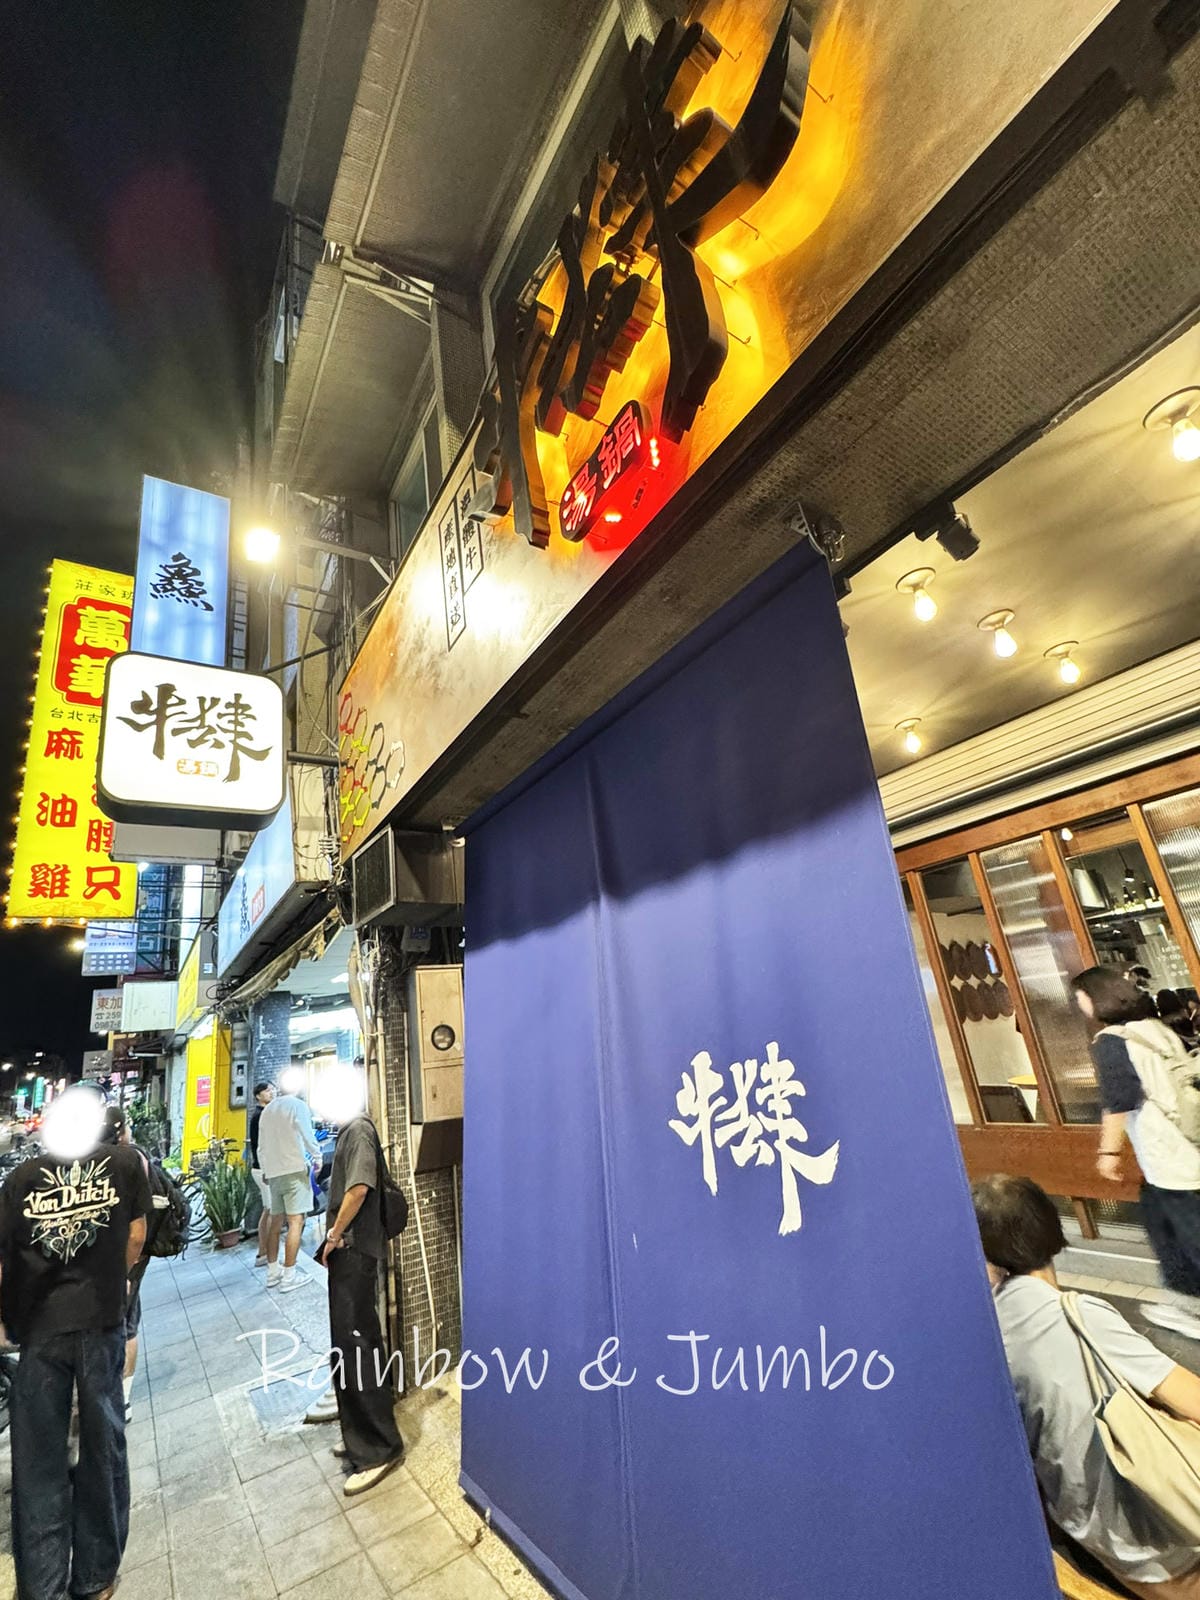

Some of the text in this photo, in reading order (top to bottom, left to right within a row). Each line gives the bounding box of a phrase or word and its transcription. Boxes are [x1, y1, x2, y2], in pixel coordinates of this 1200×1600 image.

[563, 405, 641, 531] 湯鍋
[27, 727, 85, 899] 麻油雞
[24, 1178, 116, 1214] Von Dutch
